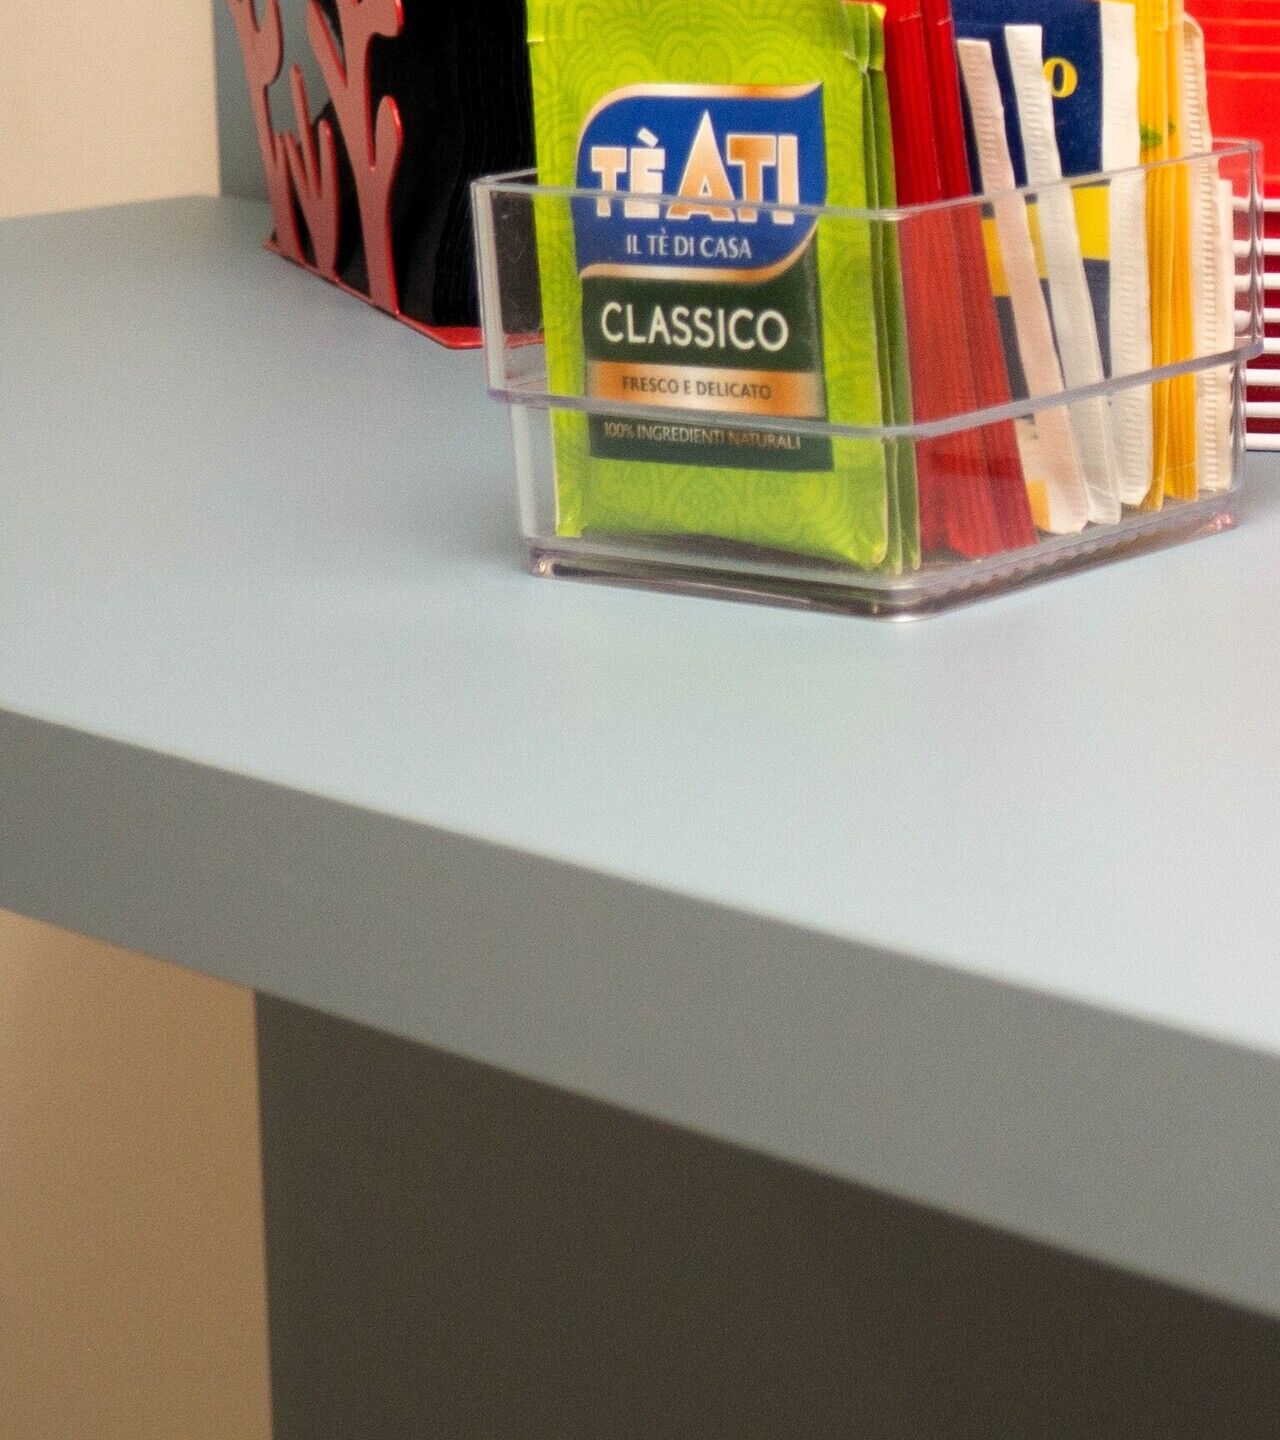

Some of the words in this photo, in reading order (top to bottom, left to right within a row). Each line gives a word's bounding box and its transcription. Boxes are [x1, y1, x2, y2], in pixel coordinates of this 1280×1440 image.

[626, 234, 642, 254] IL
[647, 227, 670, 257] TÈ
[674, 235, 695, 258] DI
[700, 236, 753, 259] CASA
[601, 301, 789, 352] CLASSICO
[621, 375, 679, 394] FRESCO
[684, 379, 691, 395] E
[695, 380, 773, 400] DELICATO
[604, 421, 633, 439] 100%
[636, 423, 725, 444] INGREDIENTI
[729, 431, 801, 450] NATURALI
